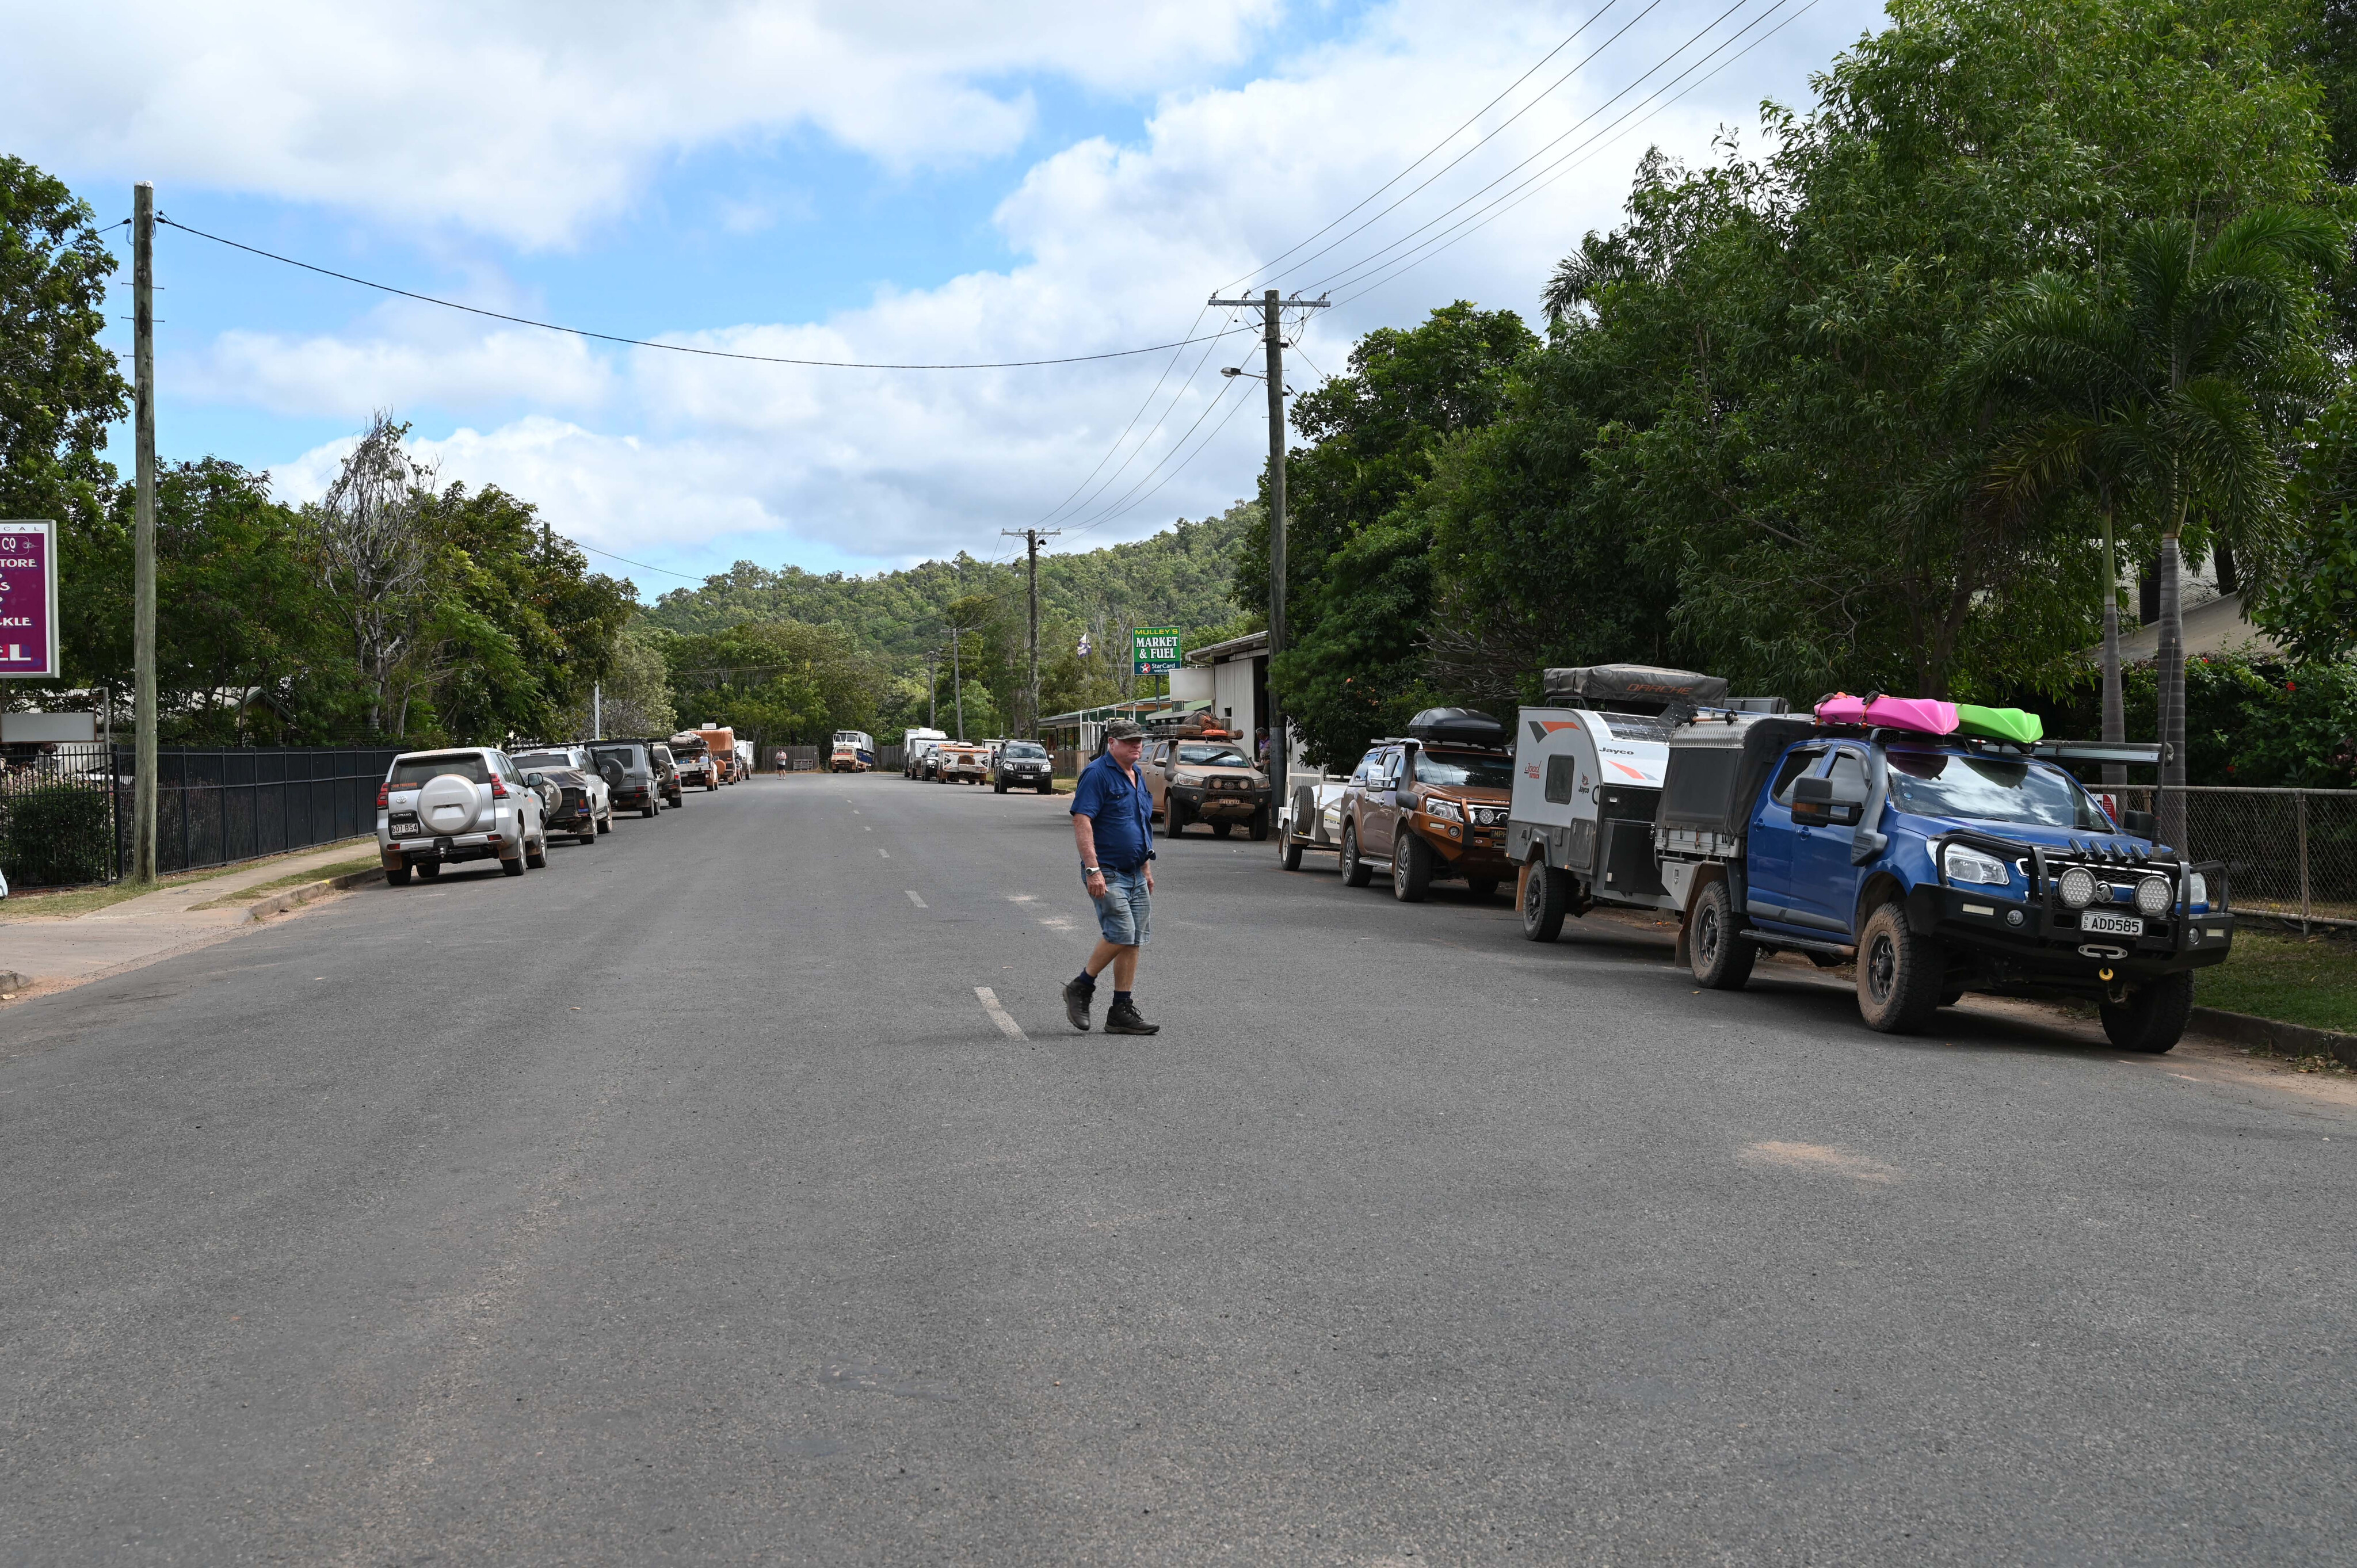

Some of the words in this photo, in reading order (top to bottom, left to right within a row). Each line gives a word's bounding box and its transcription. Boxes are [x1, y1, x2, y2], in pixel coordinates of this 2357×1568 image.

[1136, 636, 1178, 647] MARKET
[1139, 648, 1147, 659] &
[1150, 648, 1176, 659] FUEL
[1626, 684, 1694, 695] DARCHE
[1599, 747, 1634, 755] Jayco
[1578, 785, 1589, 795] Jayco
[2091, 917, 2139, 933] ADD585
